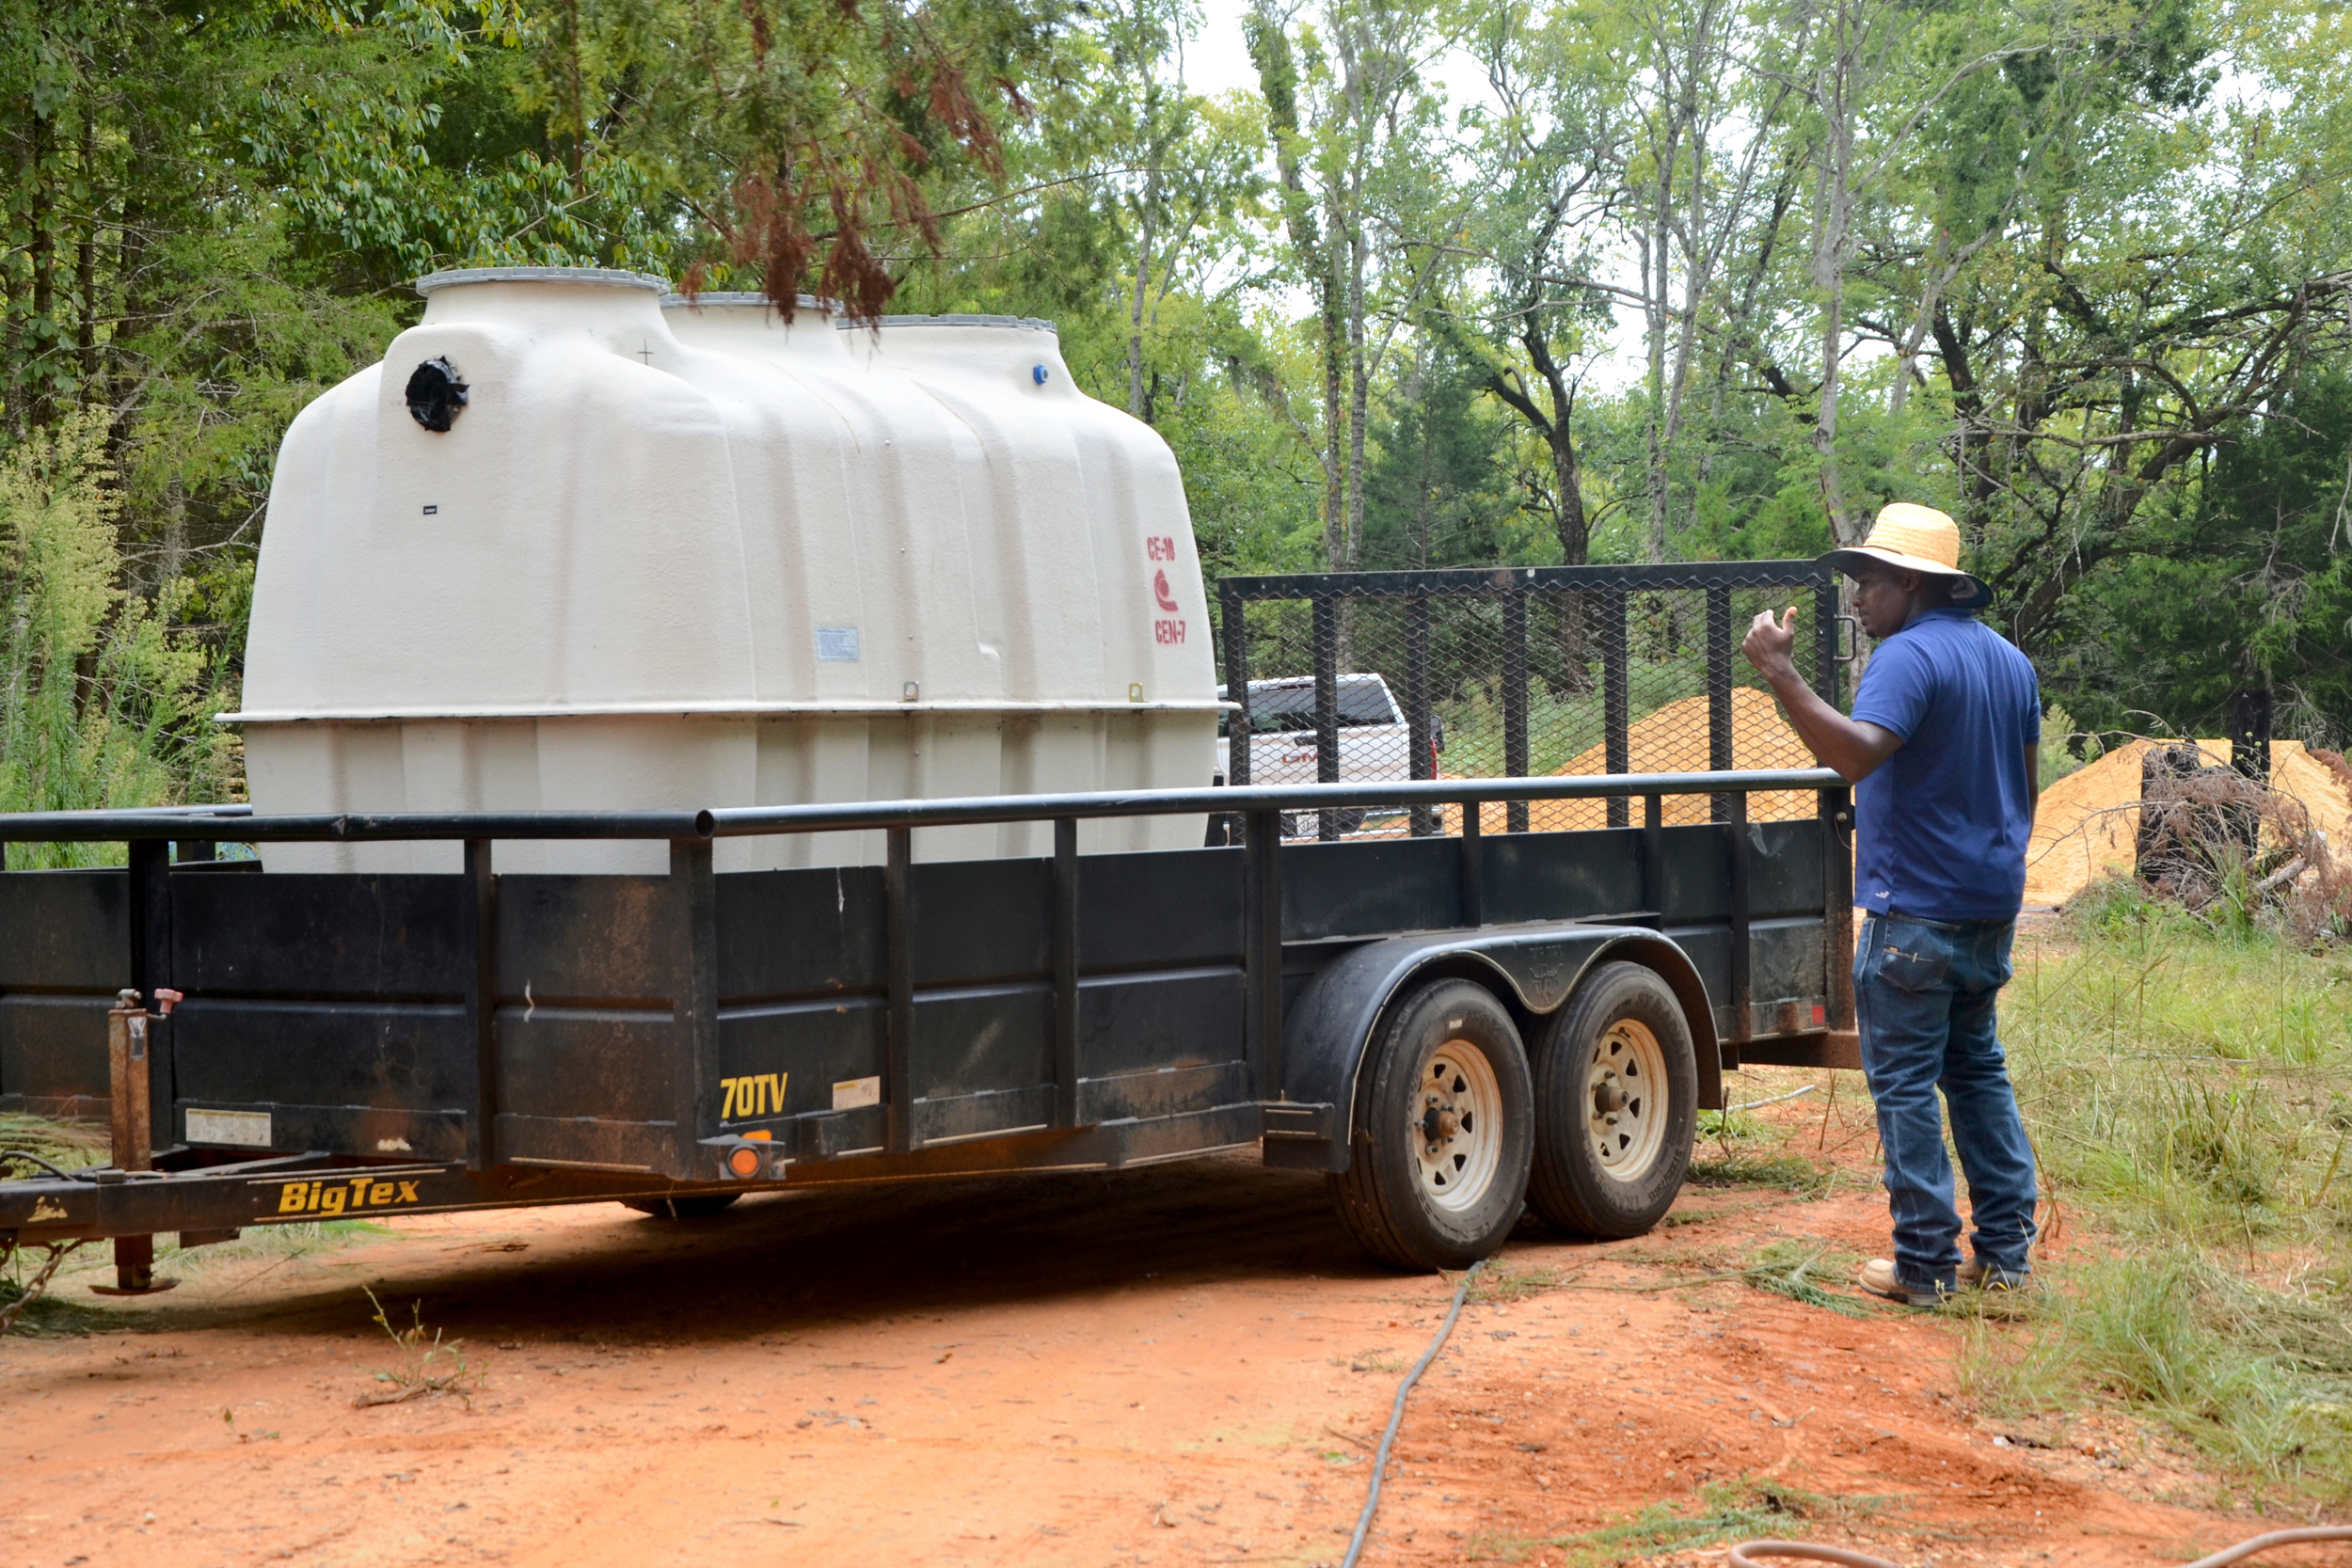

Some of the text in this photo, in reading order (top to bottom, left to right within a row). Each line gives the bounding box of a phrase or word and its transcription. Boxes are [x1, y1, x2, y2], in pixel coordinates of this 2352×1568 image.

[1147, 536, 1176, 562] CE-10
[1154, 620, 1185, 644] CEN-7
[1282, 749, 1343, 764] GM
[721, 1071, 788, 1119] 70TV
